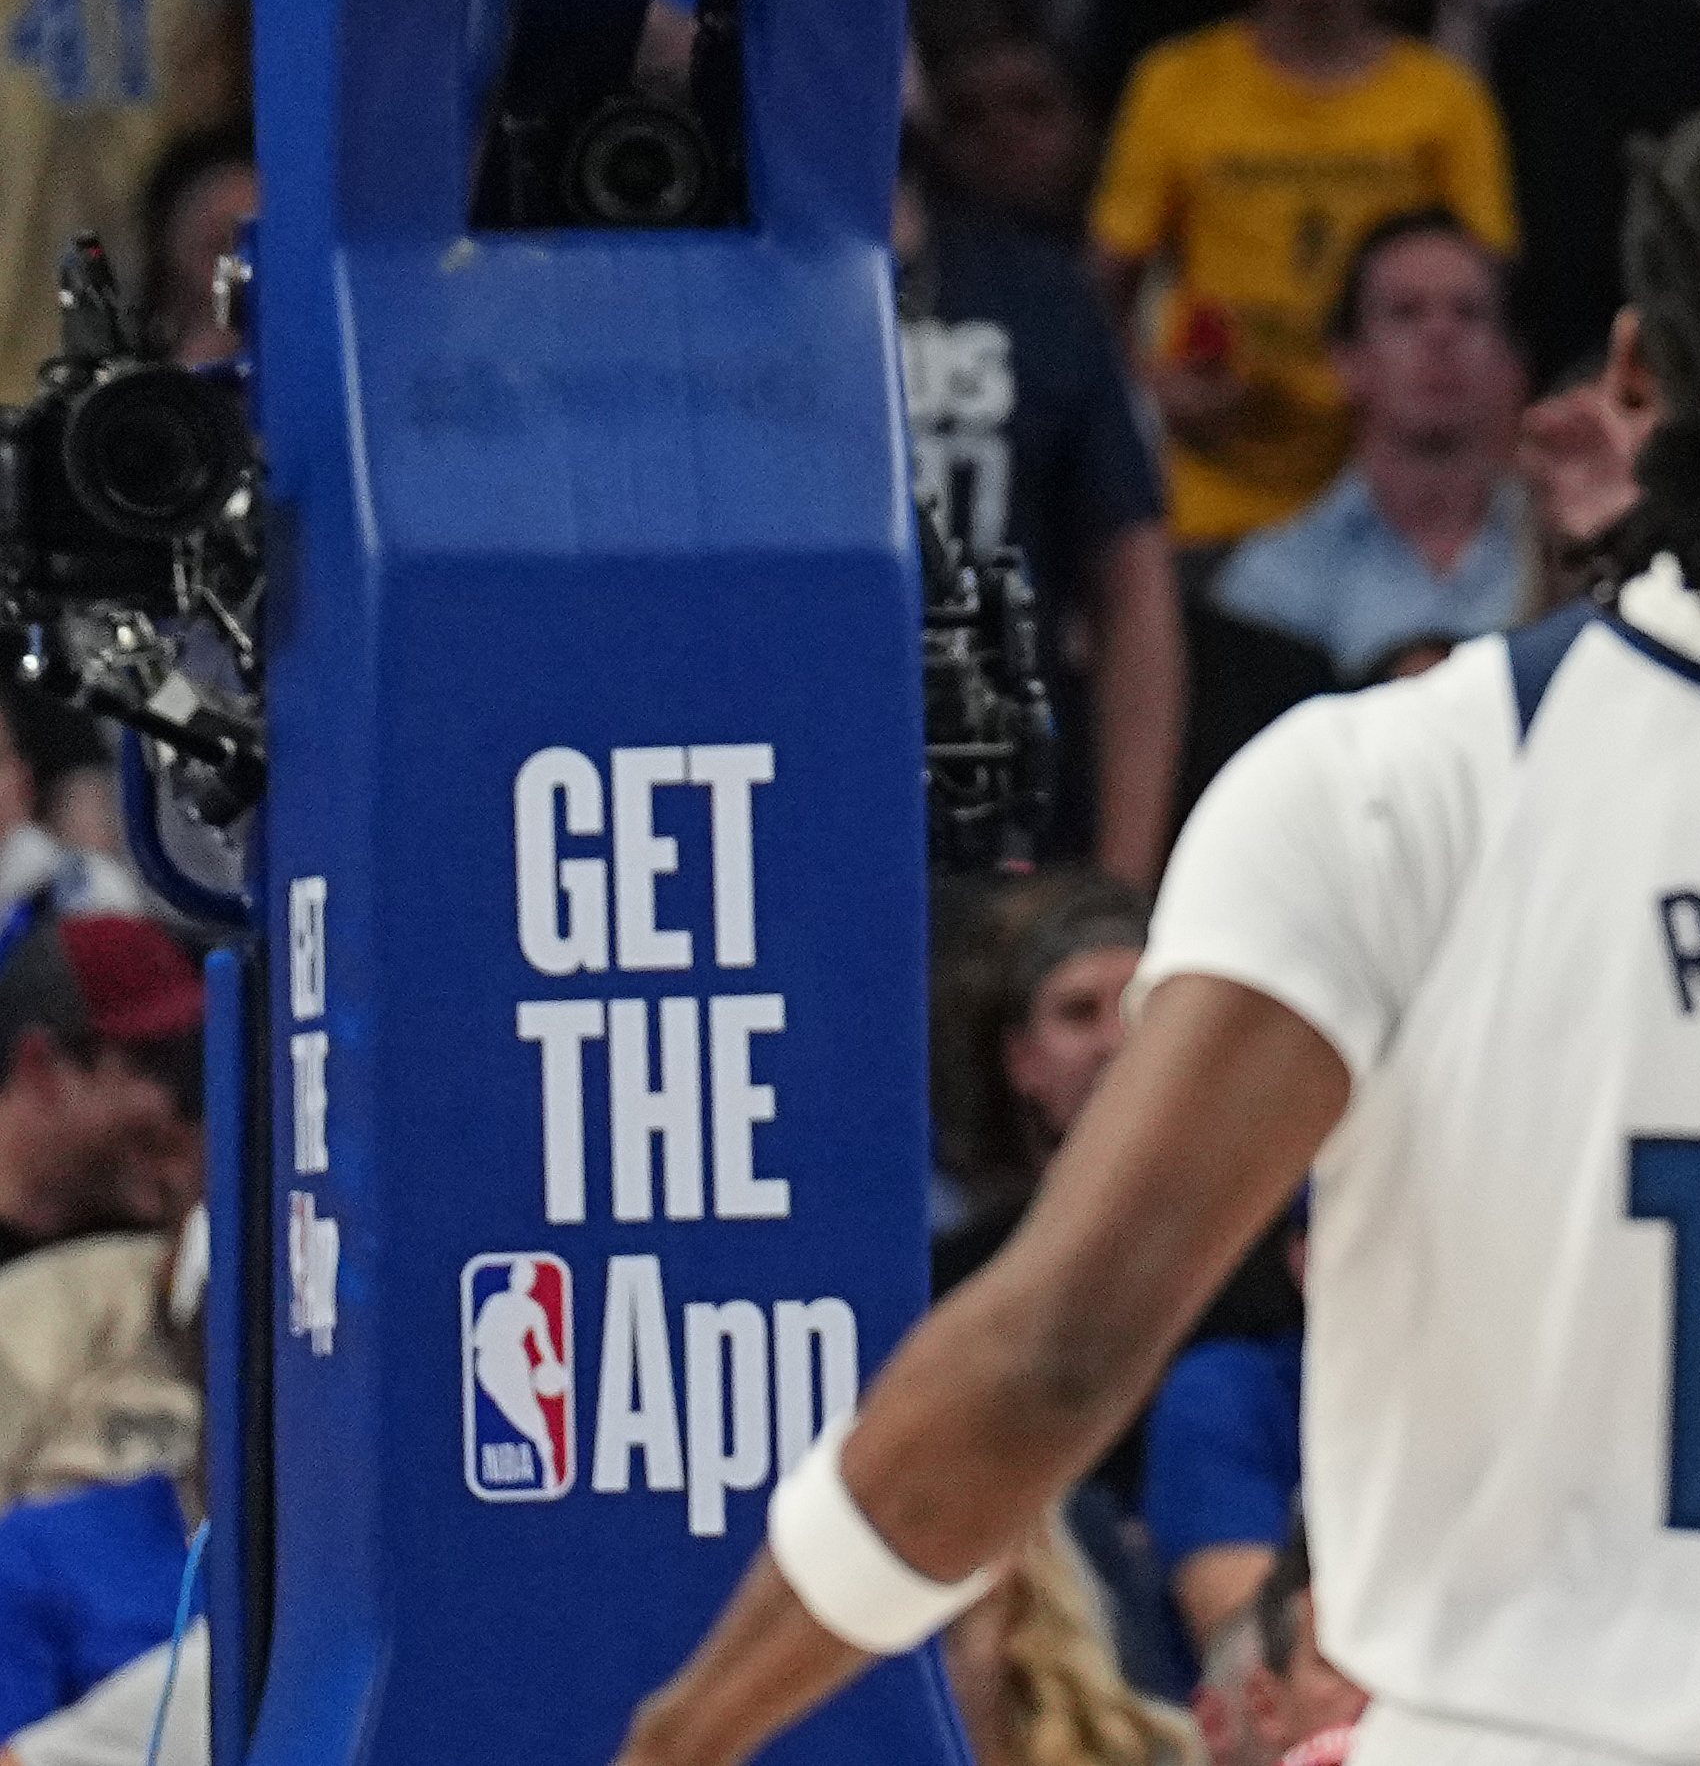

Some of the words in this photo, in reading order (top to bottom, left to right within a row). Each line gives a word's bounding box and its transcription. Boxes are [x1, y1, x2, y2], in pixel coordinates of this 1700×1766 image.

[514, 742, 776, 978] GET
[515, 991, 792, 1226] THE
[591, 1253, 859, 1536] App
